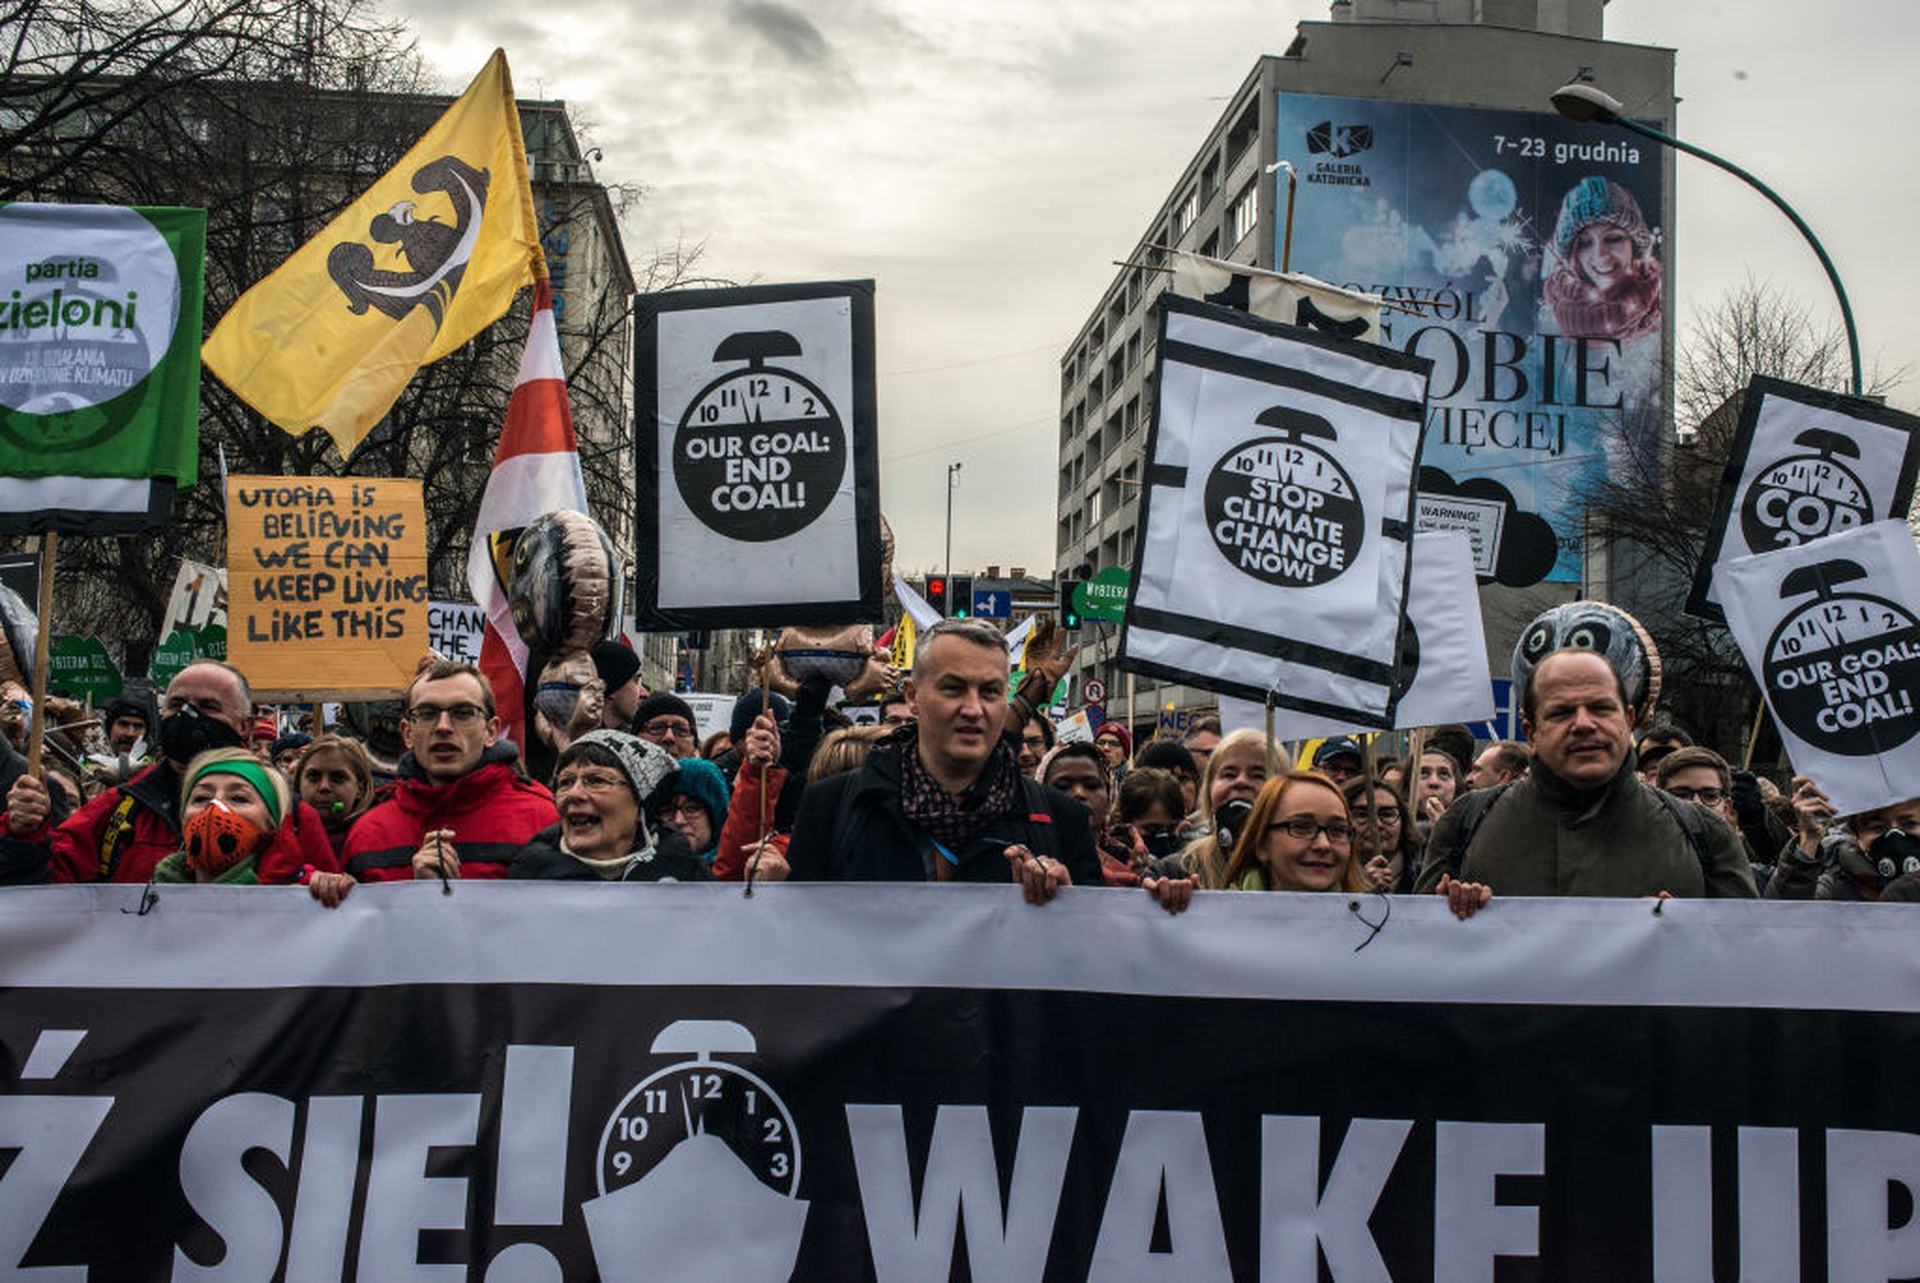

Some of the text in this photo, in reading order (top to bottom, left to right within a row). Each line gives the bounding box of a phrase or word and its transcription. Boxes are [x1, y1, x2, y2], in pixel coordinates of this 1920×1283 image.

[1555, 141, 1640, 164] grudnia
[1307, 173, 1371, 187] KATOWICKA
[1316, 162, 1363, 175] GALERIA
[26, 257, 99, 284] partia
[1380, 322, 1624, 410] OBIE
[721, 389, 737, 408] 11
[749, 379, 771, 399] 12
[784, 386, 791, 404] 1
[700, 404, 719, 423] 10
[802, 397, 817, 416] 2
[685, 431, 831, 460] OUR GOAL:
[1285, 448, 1304, 466] 12
[1236, 456, 1255, 472] 10
[1257, 449, 1273, 466] 11
[1316, 461, 1323, 477] 1
[725, 456, 792, 484] END
[1772, 471, 1788, 485] 10
[1791, 464, 1805, 479] 11
[1814, 464, 1831, 480] 12
[1331, 477, 1343, 494] 2
[1837, 477, 1844, 490] 1
[711, 481, 806, 512] COAL!
[1249, 478, 1325, 513] STOP
[1849, 489, 1860, 505] 2
[1223, 496, 1343, 546] CLIMATE
[1420, 505, 1480, 522] WARNING!
[1755, 488, 1862, 536] COP
[253, 540, 389, 569] WE CAN
[1214, 520, 1346, 571] CHANGE
[1240, 550, 1316, 582] NOW!
[254, 572, 336, 602] KEEP
[427, 608, 487, 635] CHAN
[1823, 604, 1847, 624] 12
[1859, 606, 1869, 623] 1
[1882, 612, 1899, 630] 2
[1797, 620, 1816, 638] 11
[428, 633, 469, 656] THE
[1781, 636, 1801, 656] 10
[1776, 639, 1920, 689] OUR GOAL:
[1820, 669, 1890, 706] END
[1816, 689, 1914, 733] COAL!
[689, 1074, 723, 1099] 12
[644, 1090, 668, 1114] 11
[744, 1090, 757, 1115] 1
[618, 1116, 649, 1141] 10
[763, 1118, 783, 1142] 2
[612, 1151, 633, 1177] 9
[769, 1152, 789, 1178] 3
[845, 1103, 1920, 1283] WAKE UP
